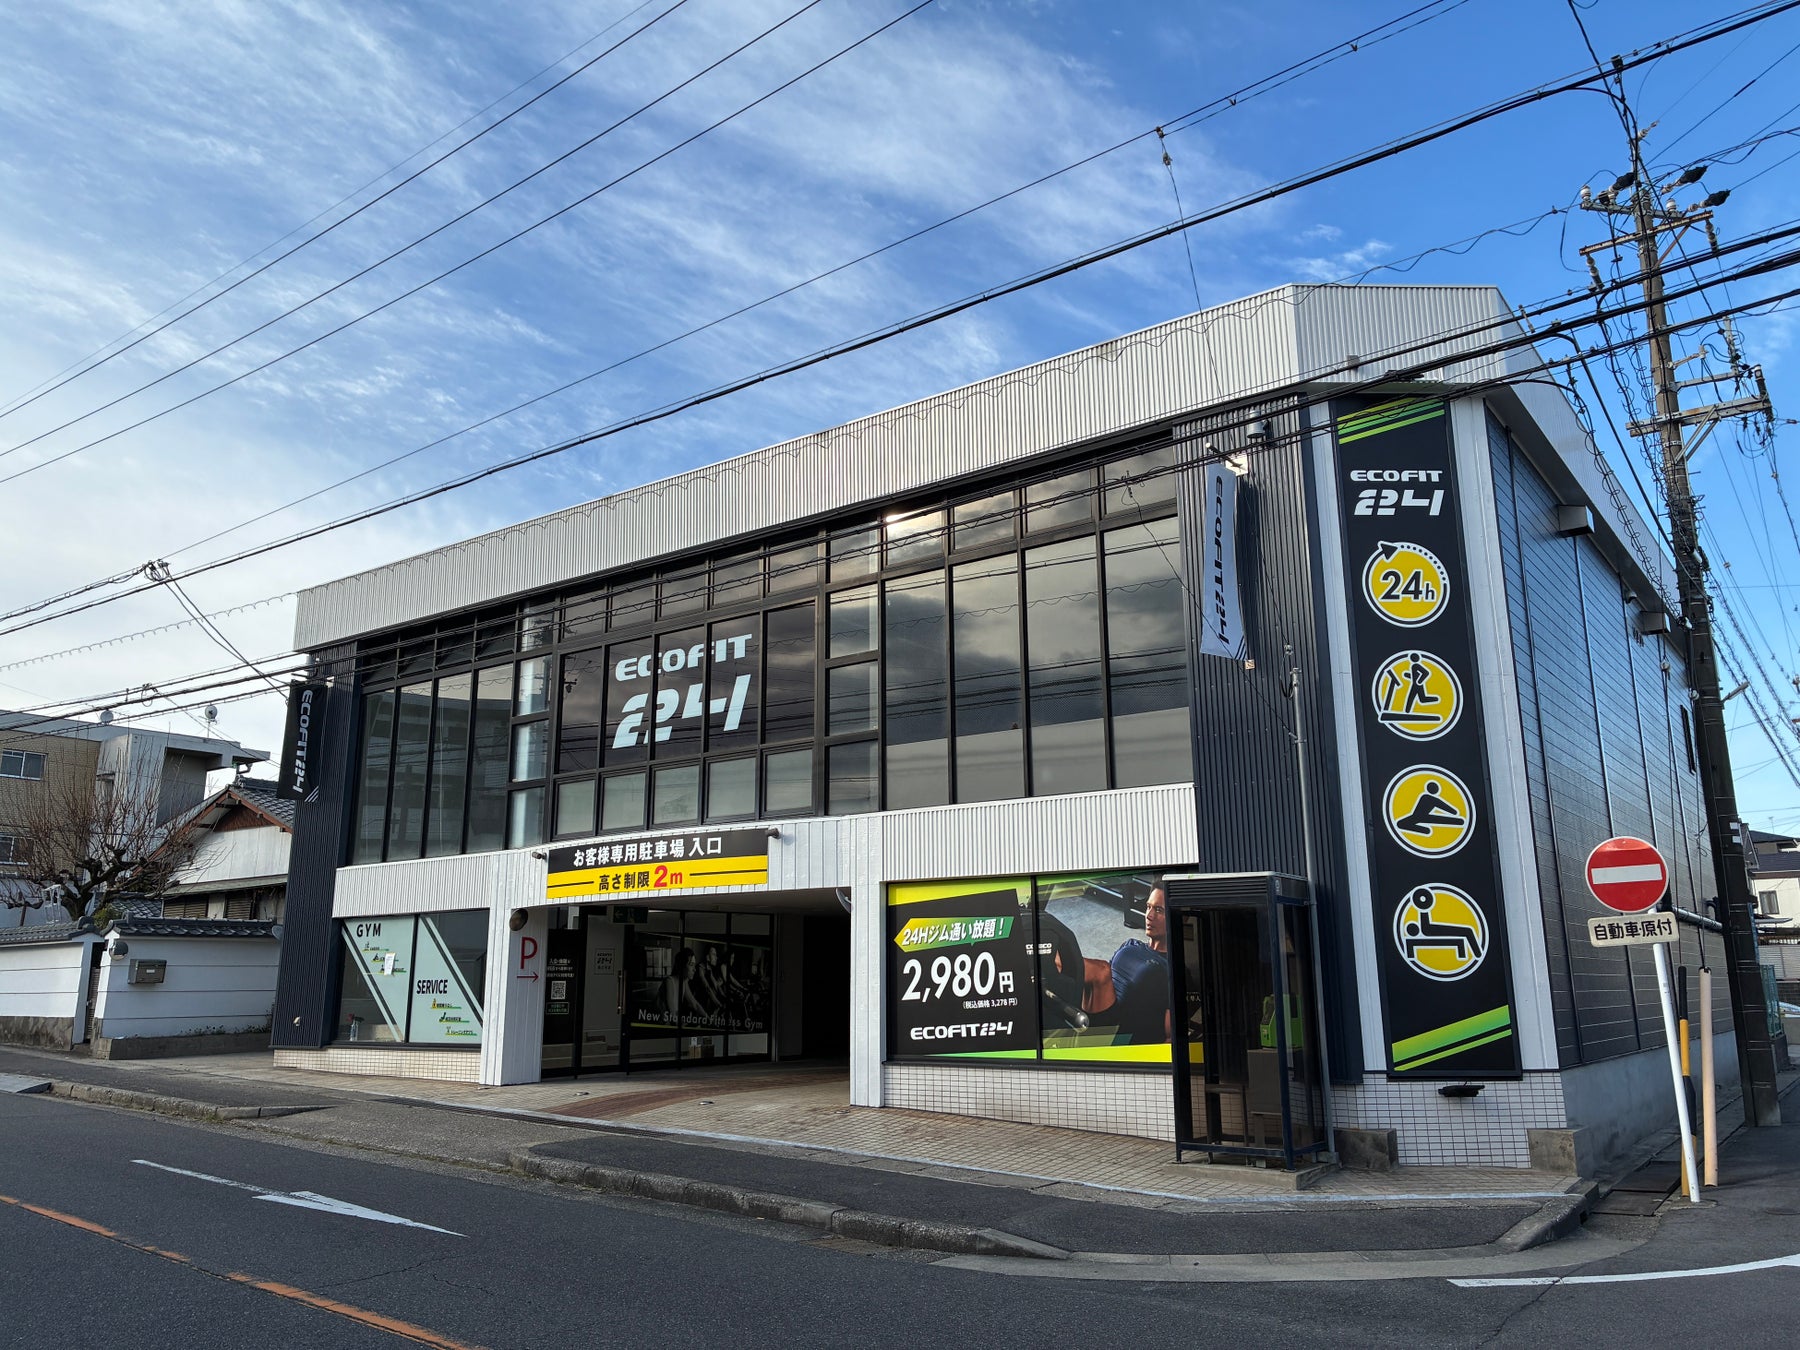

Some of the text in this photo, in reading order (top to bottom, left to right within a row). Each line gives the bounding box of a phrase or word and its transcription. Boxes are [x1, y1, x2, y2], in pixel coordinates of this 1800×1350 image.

[1350, 470, 1443, 482] ECOFIT
[1354, 489, 1445, 516] 24
[1380, 570, 1435, 601] 24h
[615, 633, 752, 682] ECOFIT
[612, 674, 751, 749] 24
[292, 689, 313, 794] ECOFIT24
[573, 836, 722, 867] お客様専用駐車場 入口
[356, 922, 382, 938] GYM
[902, 918, 1004, 946] 24Hジム通い放題!
[520, 936, 538, 970] P
[416, 979, 448, 995] SERVICE
[638, 1008, 661, 1022] New
[663, 1011, 708, 1025] Standard
[744, 1018, 763, 1032] Gym
[910, 1021, 1013, 1040] ECOFIT24
